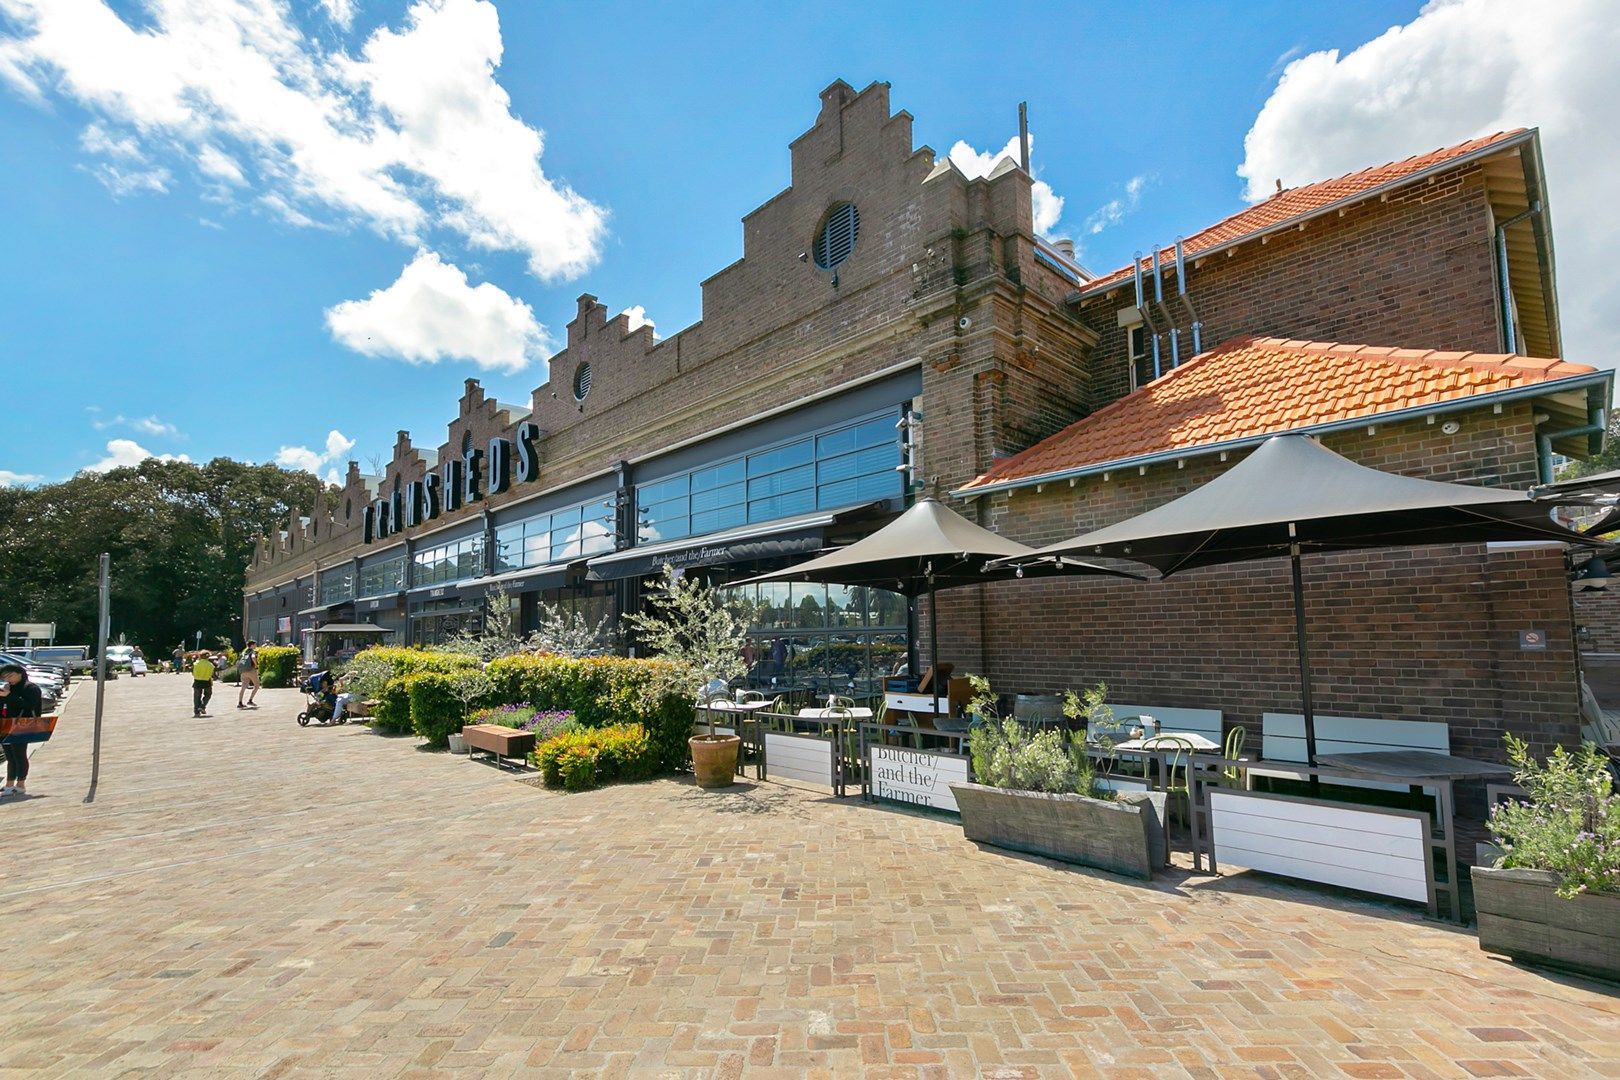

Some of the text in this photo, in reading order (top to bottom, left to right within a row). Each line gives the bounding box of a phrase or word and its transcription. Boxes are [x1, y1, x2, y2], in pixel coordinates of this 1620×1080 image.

[363, 421, 540, 545] TRAMSHEDS
[676, 550, 688, 562] and
[701, 547, 726, 558] Farmer
[878, 764, 904, 782] and
